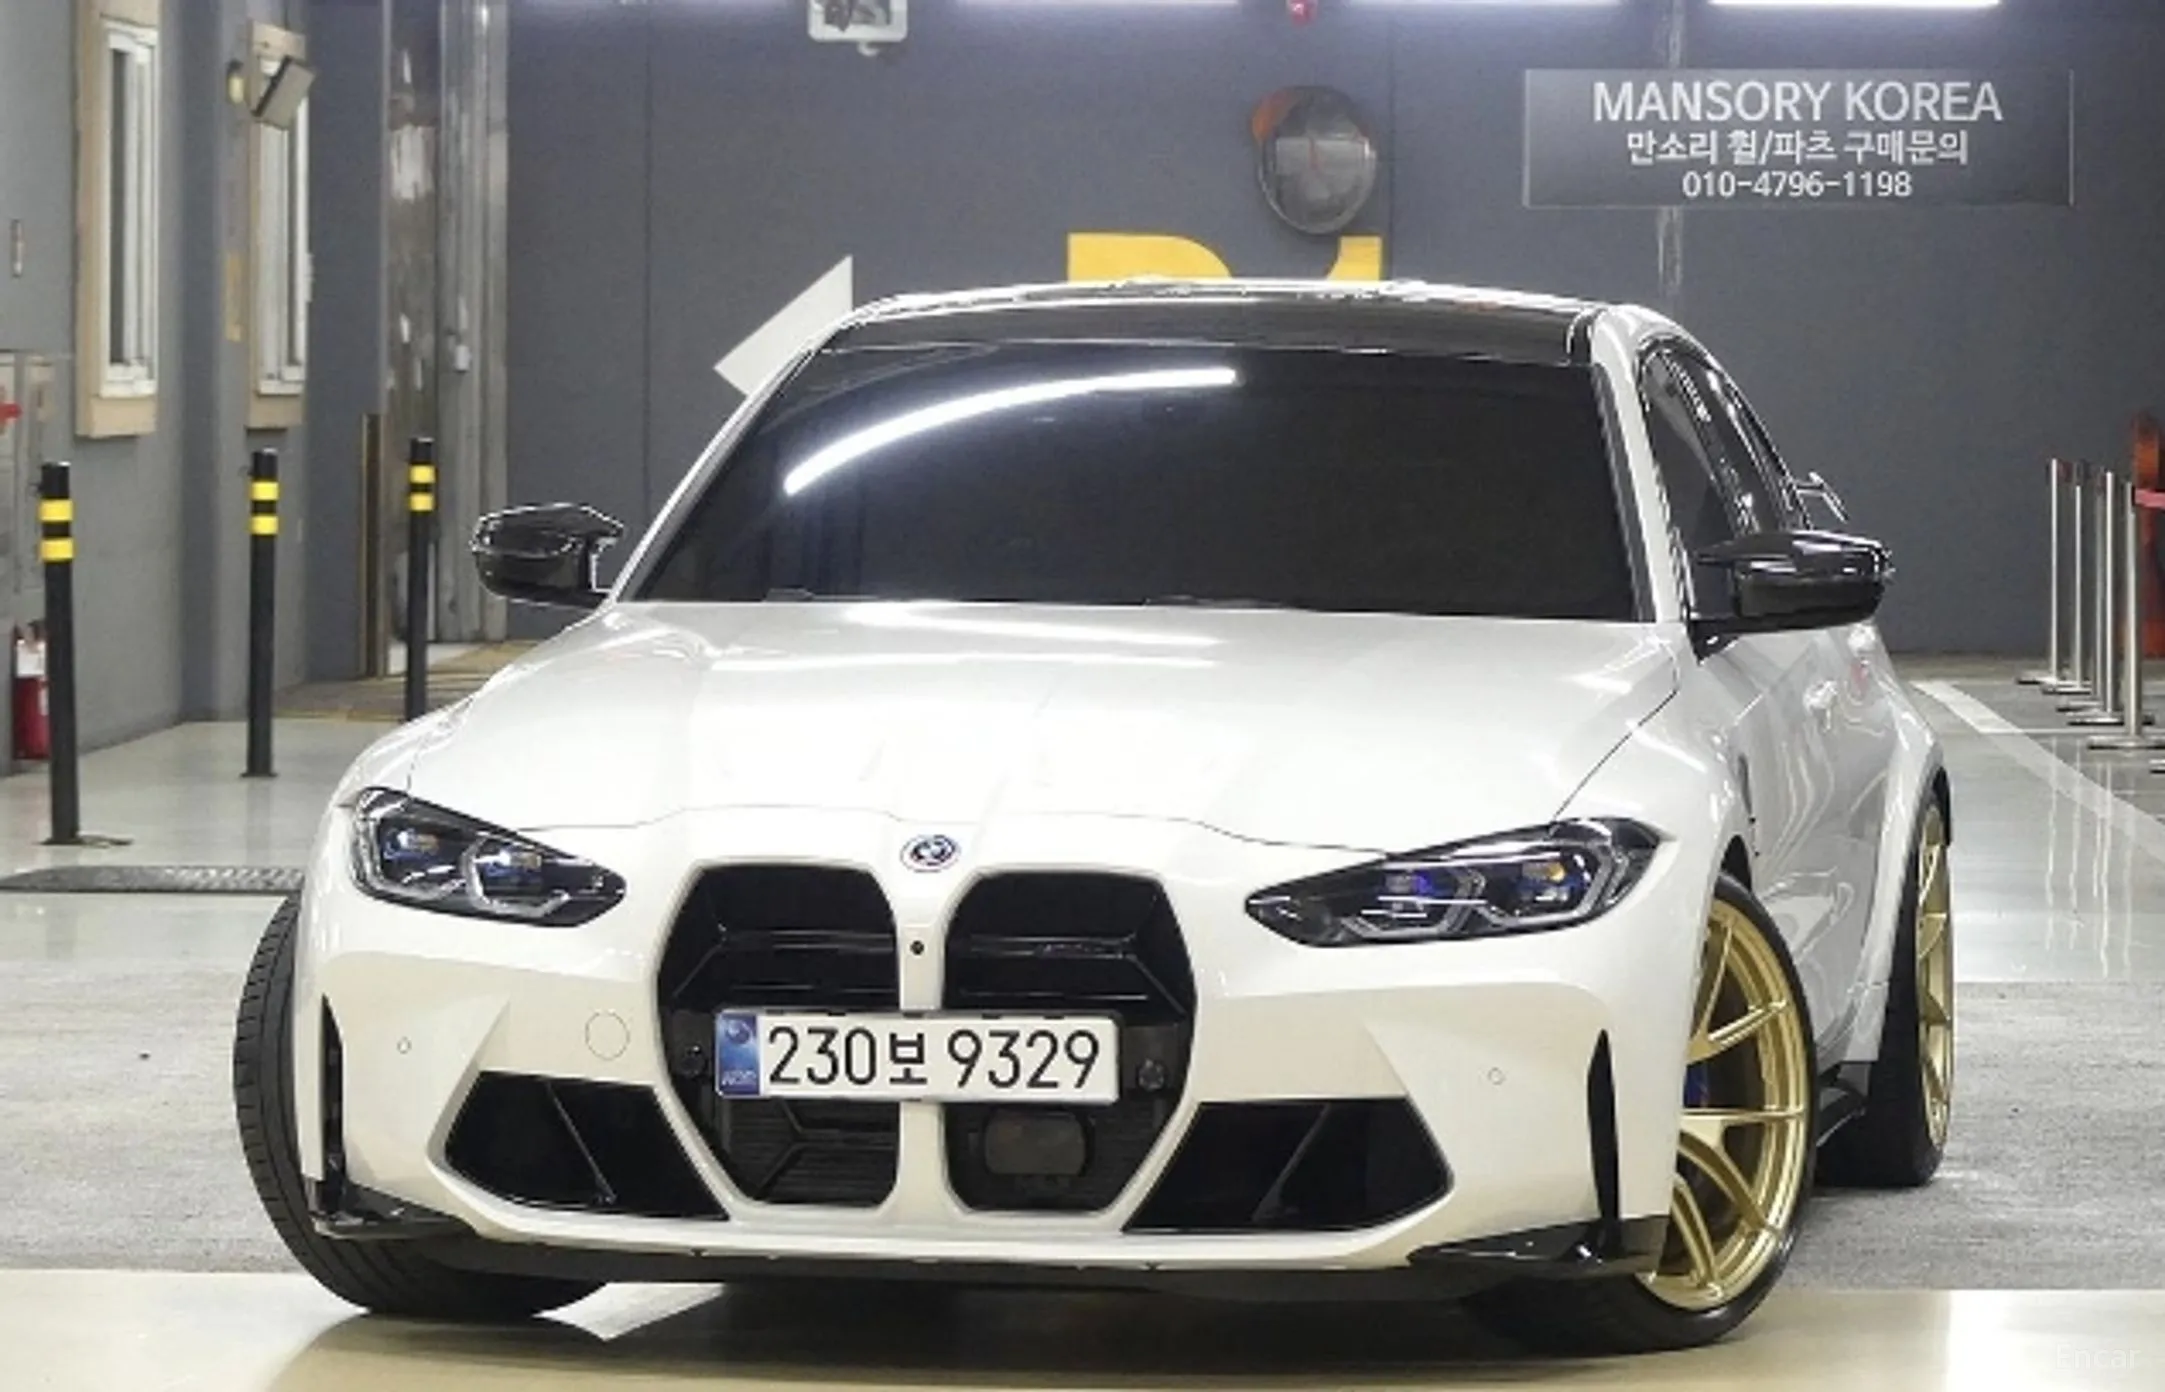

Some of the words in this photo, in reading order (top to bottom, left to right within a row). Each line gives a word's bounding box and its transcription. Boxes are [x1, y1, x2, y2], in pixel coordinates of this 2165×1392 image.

[1593, 80, 1832, 123] MANSORY
[1845, 80, 2004, 123] KOREA
[1626, 129, 1718, 166] 만소리
[1843, 129, 1968, 166] 구매문의
[1682, 170, 1913, 198] 010-4796-1198
[768, 1025, 928, 1086] 230보
[946, 1028, 1101, 1089] 9329
